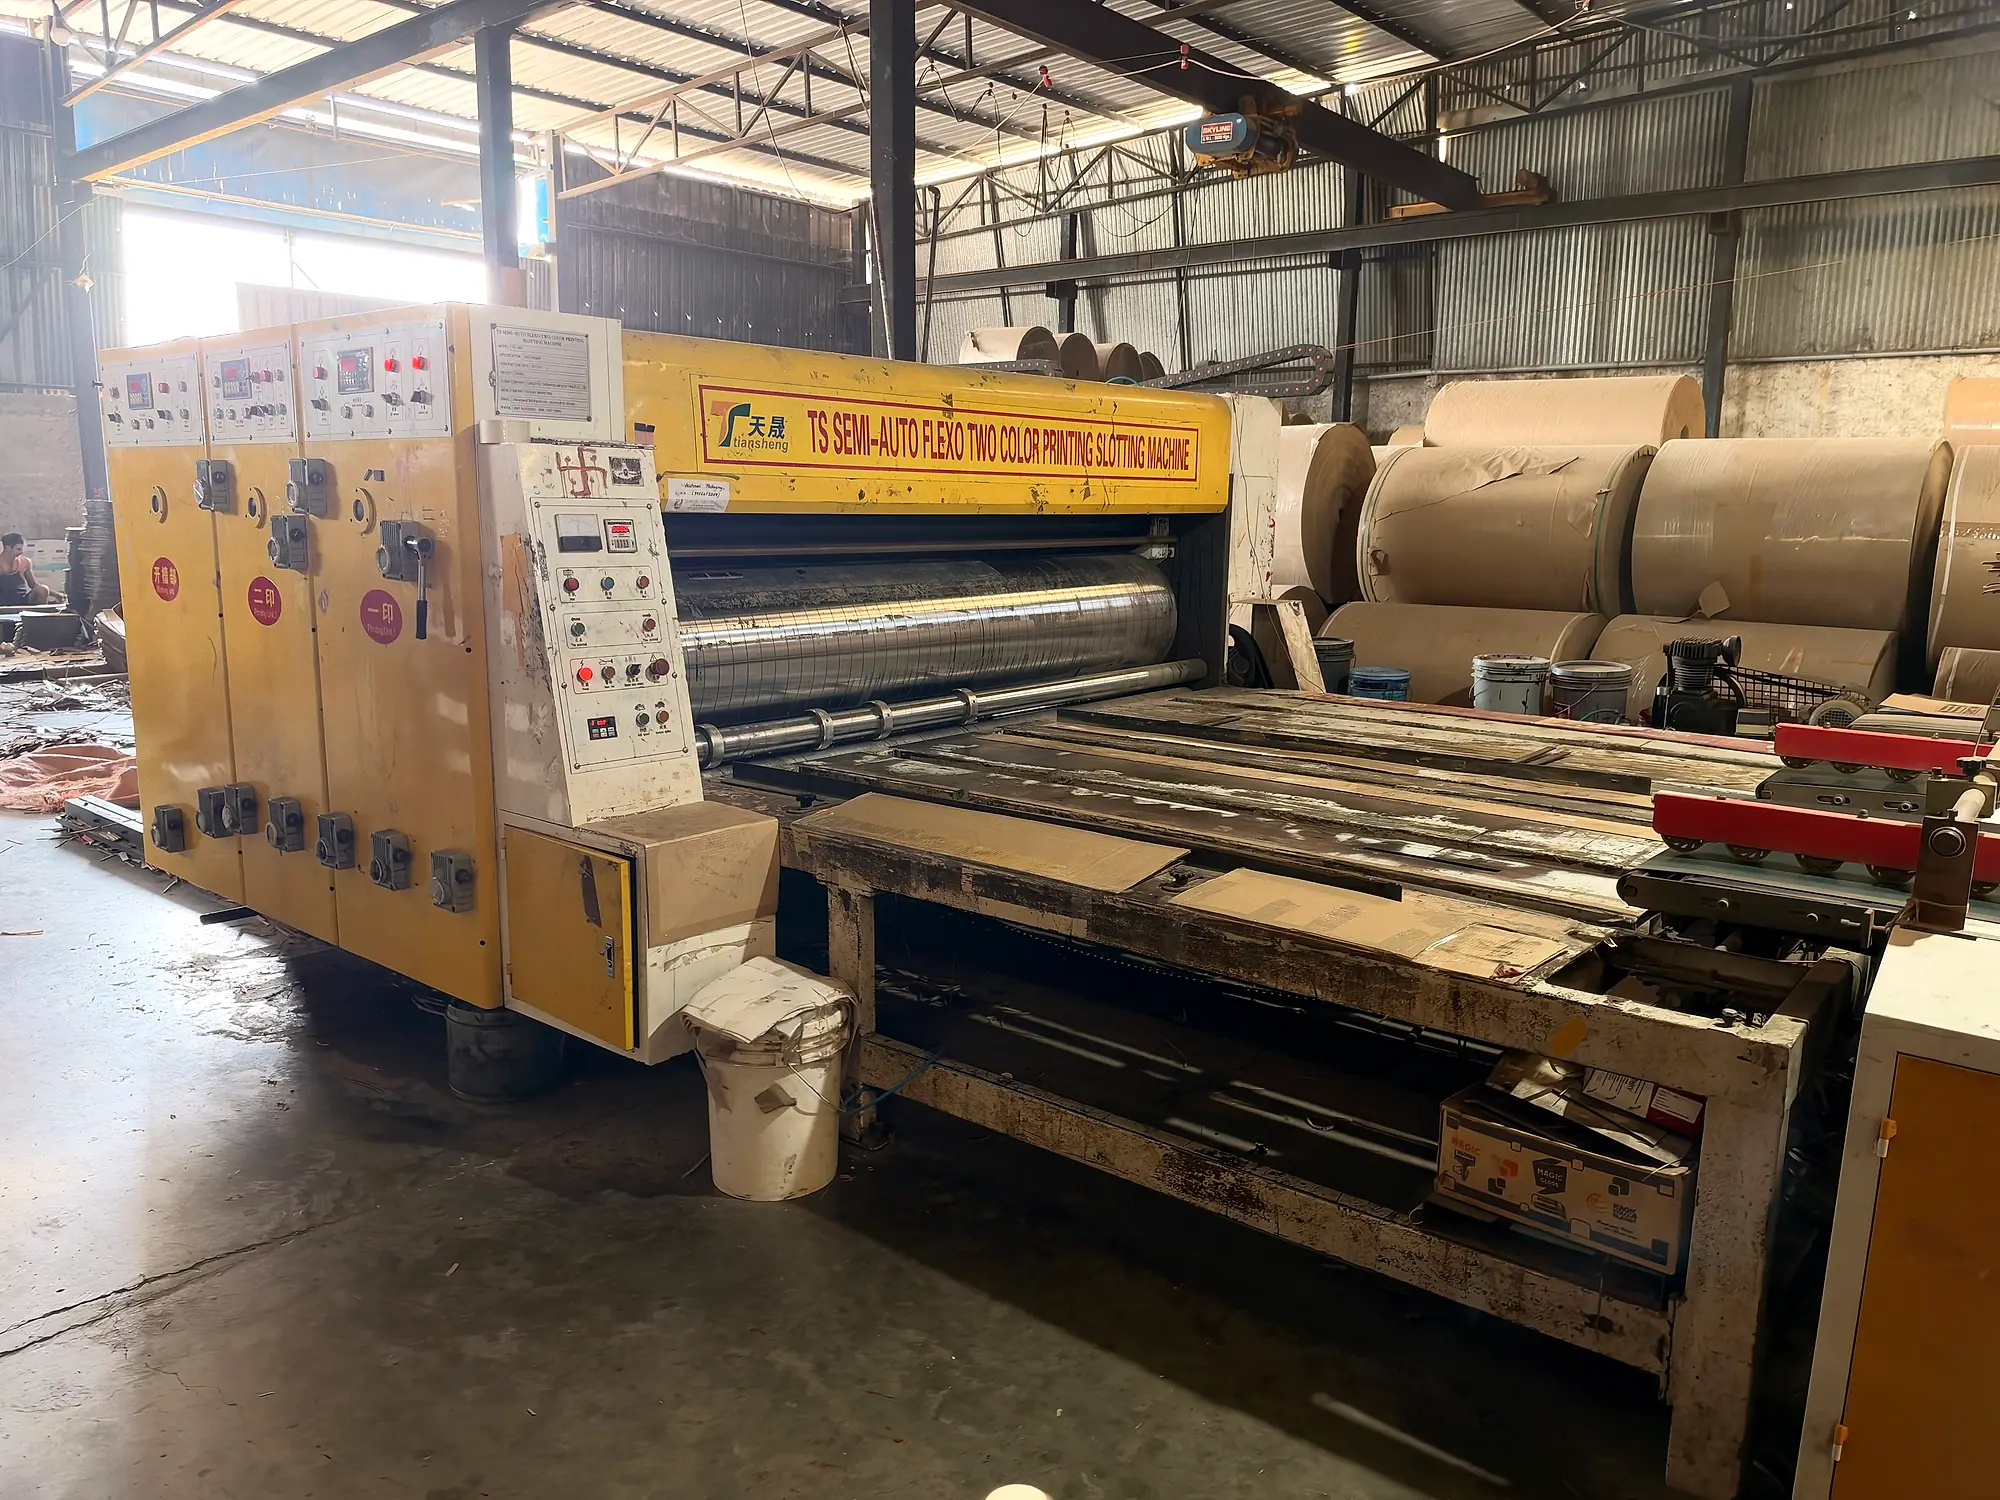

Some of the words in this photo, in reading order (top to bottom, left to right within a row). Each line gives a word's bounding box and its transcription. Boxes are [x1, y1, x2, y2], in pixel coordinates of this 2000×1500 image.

[748, 415, 785, 439] 天晟
[733, 437, 789, 453] tiansheng
[807, 410, 829, 454] TS
[833, 411, 919, 458] SEMI-AUTO
[923, 419, 963, 461] FLEXO
[967, 422, 997, 462] TWO
[1000, 424, 1040, 464] COLOR
[1043, 428, 1093, 467] PRINTING
[1096, 432, 1145, 469] SLOTTING
[1147, 435, 1190, 471] MACHINE
[254, 588, 275, 607] 二印
[367, 603, 393, 624] 一印
[1537, 1167, 1563, 1182] MAGIC
